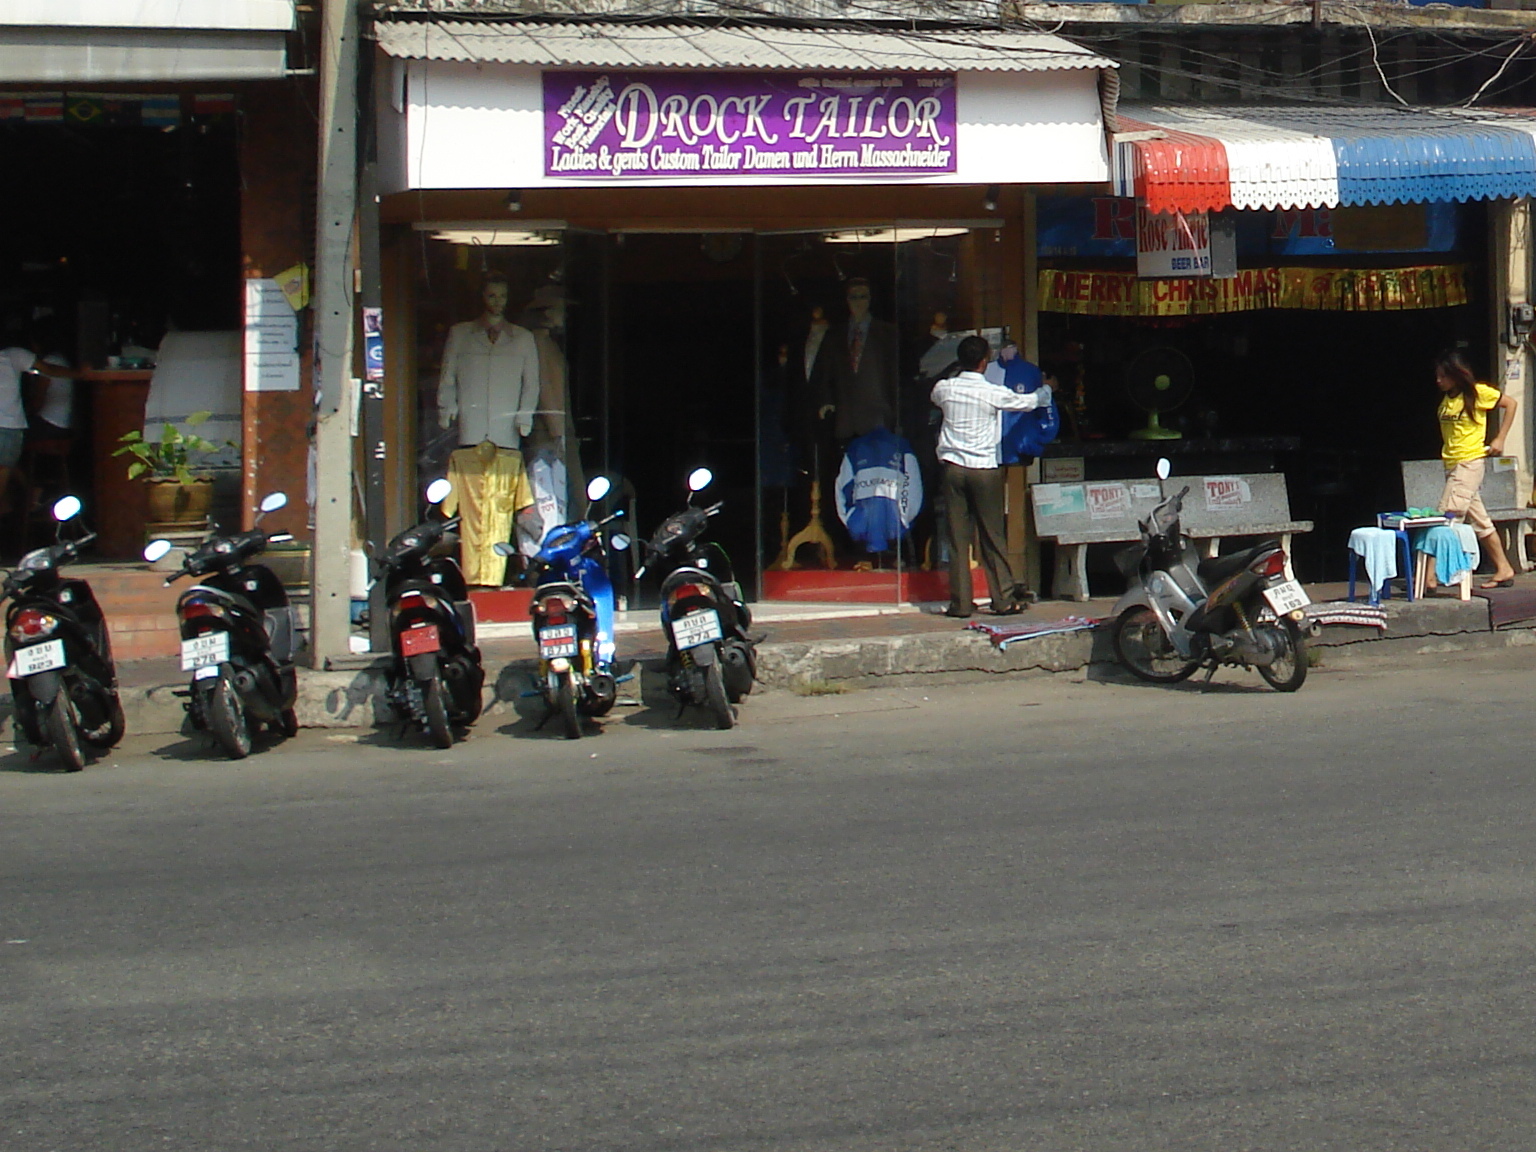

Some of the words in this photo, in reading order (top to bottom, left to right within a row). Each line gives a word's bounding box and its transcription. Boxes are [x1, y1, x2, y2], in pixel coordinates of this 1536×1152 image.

[583, 87, 615, 124] Quality
[614, 82, 778, 148] DROCK
[783, 93, 950, 146] TAILOR
[551, 146, 597, 171] Ladies
[599, 145, 612, 170] &
[612, 148, 649, 176] gents
[651, 145, 700, 170] Custom
[702, 144, 742, 169] Tailor
[743, 145, 790, 169] Damen
[792, 144, 818, 168] und
[819, 144, 858, 168] Herrn
[1139, 206, 1167, 253] Rose
[1171, 257, 1191, 270] BEER
[1053, 271, 1137, 303] MERRY
